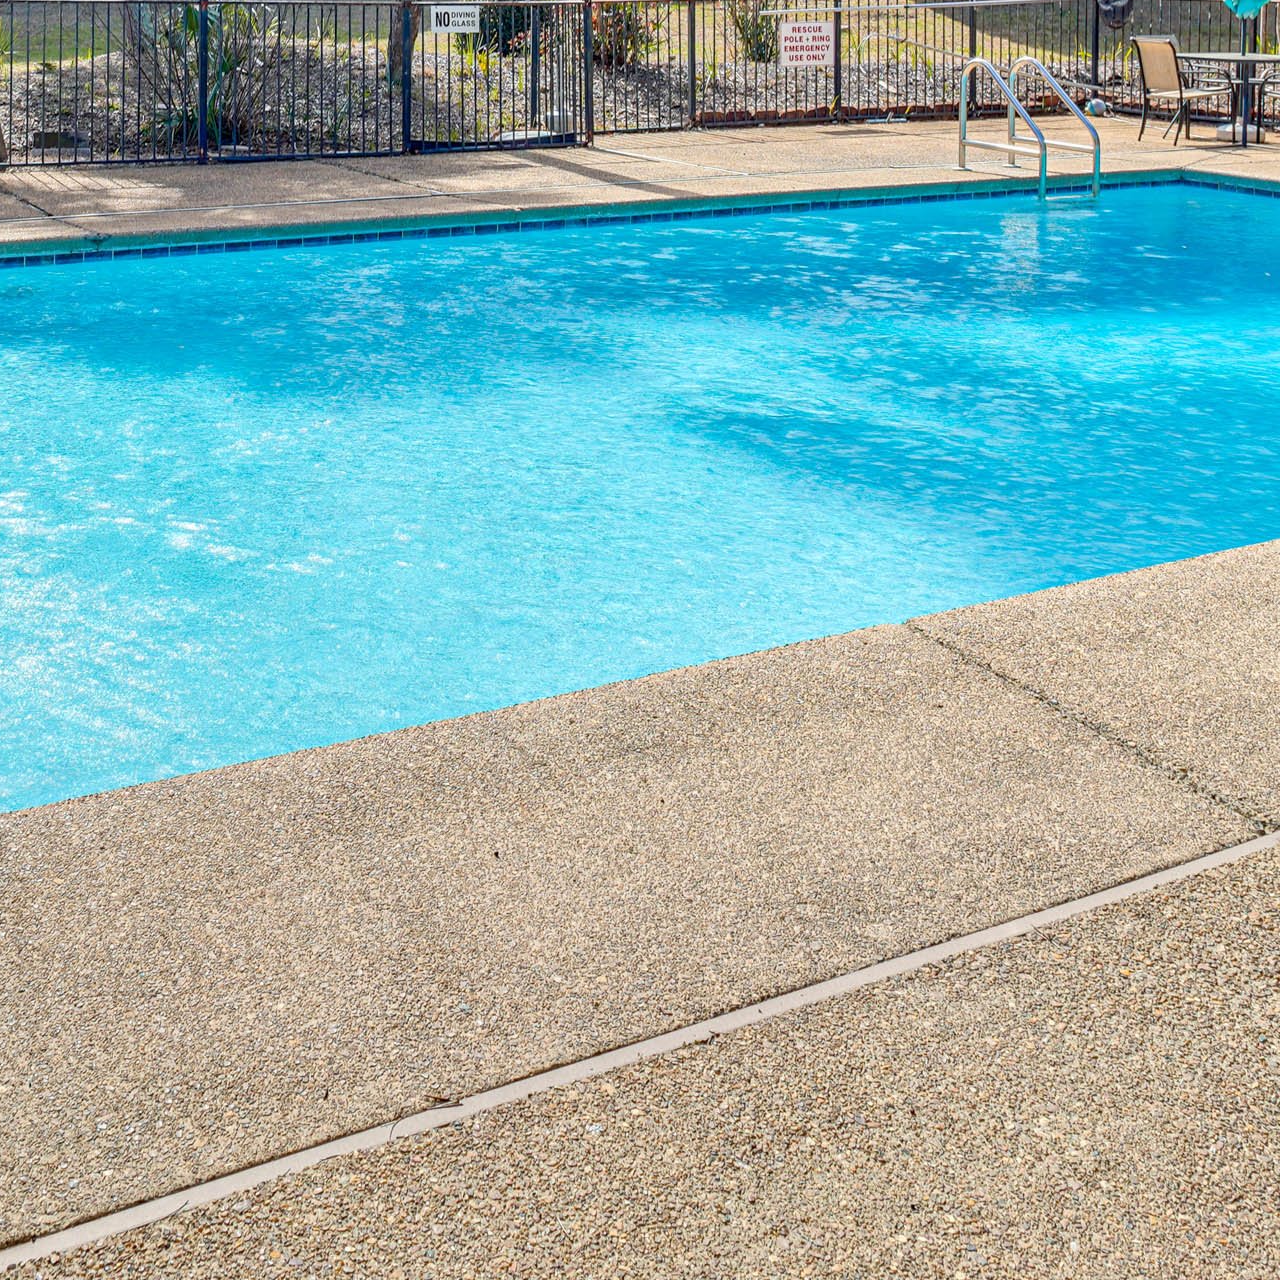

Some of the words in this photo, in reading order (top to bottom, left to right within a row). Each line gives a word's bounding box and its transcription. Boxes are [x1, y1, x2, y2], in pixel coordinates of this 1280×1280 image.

[435, 11, 450, 27] NO
[784, 35, 804, 43] POLE
[784, 44, 830, 52] EMERGENCY
[806, 53, 825, 61] ONLY
